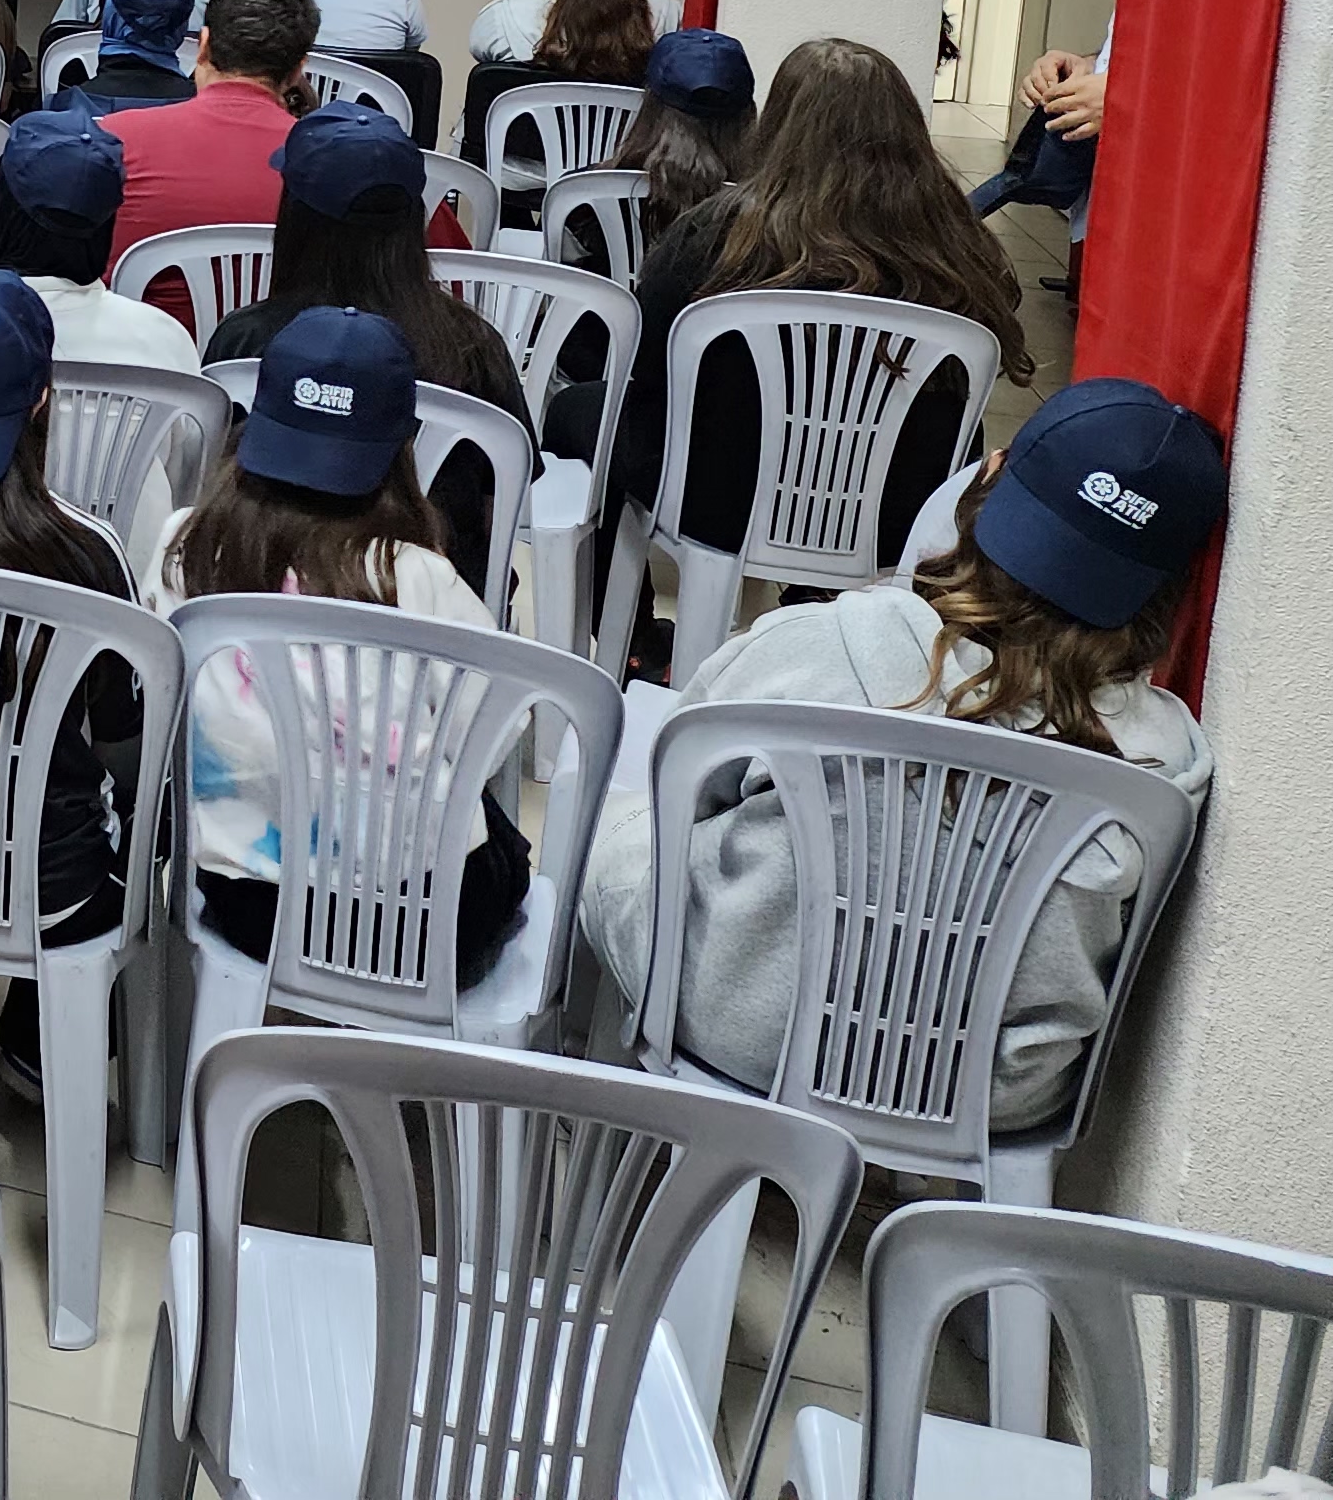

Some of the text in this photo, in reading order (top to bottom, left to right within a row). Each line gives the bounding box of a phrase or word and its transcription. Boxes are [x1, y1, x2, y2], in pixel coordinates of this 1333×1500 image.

[320, 384, 354, 399] SIFIR
[319, 395, 354, 411] ATIK
[1111, 500, 1153, 525] ATIK
[1119, 489, 1159, 516] SIFIR
